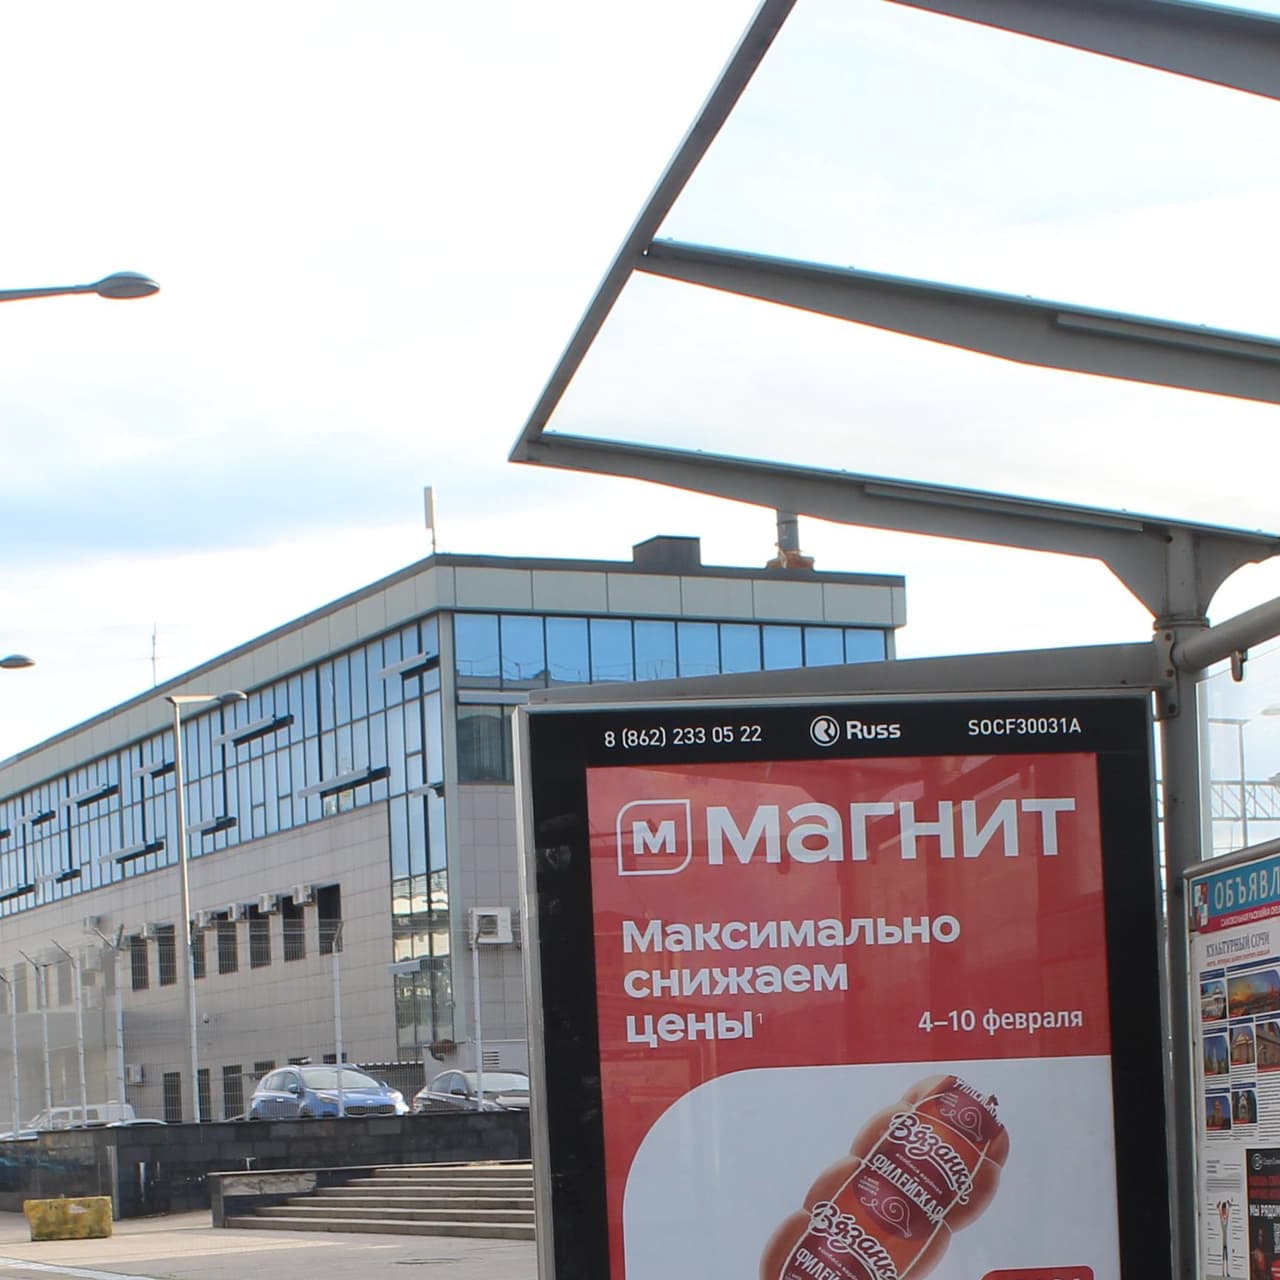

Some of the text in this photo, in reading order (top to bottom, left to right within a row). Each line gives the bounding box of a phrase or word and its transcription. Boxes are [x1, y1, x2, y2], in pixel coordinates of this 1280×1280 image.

[604, 725, 762, 748] 8 (862) 233 05 22
[846, 721, 901, 739] Russ
[622, 915, 960, 953] Максимально
[624, 963, 849, 998] снижаем
[983, 1009, 1083, 1035] февраля
[872, 1154, 945, 1225] ФИЛЕЙСКАЯ
